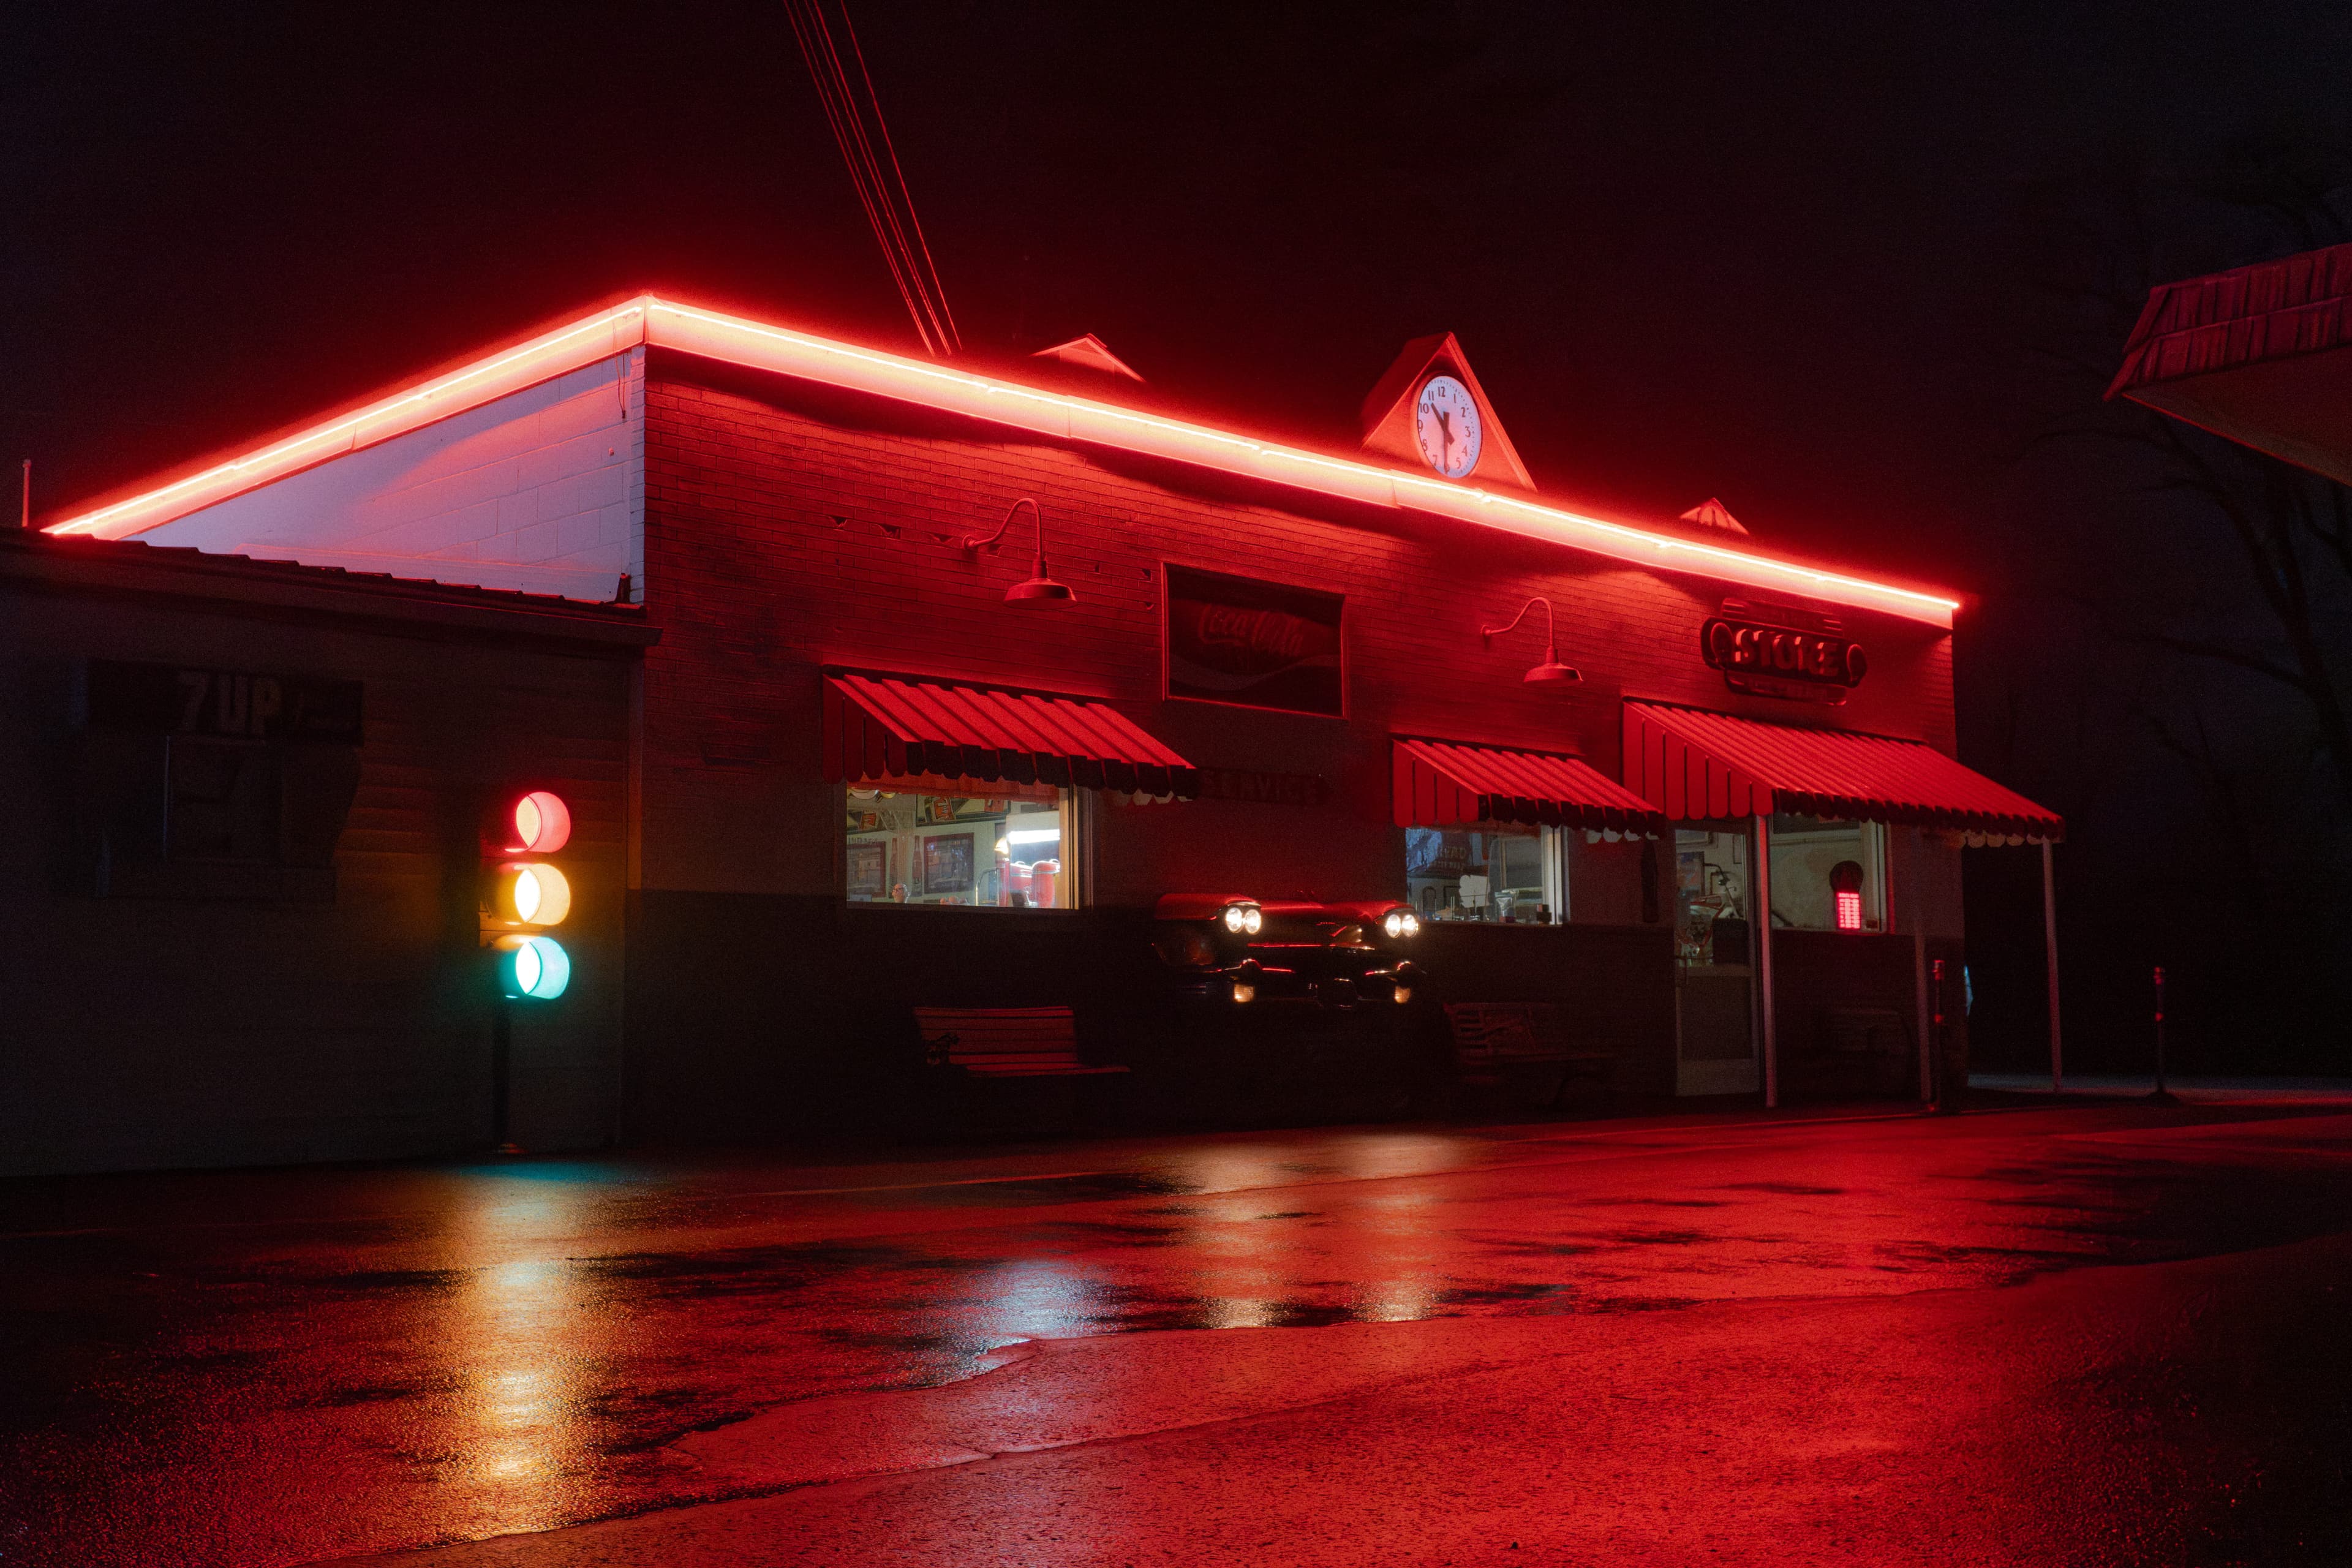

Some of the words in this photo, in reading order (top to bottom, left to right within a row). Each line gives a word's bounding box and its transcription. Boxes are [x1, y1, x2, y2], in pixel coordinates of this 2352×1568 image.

[1428, 390, 1434, 401] 11
[1438, 386, 1446, 397] 12
[1453, 394, 1457, 403] 1
[1419, 402, 1429, 413] 10
[1461, 407, 1466, 418] 2
[1418, 420, 1423, 432] 9
[1465, 426, 1471, 437] 3
[1422, 439, 1428, 451] 8
[1461, 445, 1468, 456] 4
[1432, 454, 1438, 466] 7
[1456, 457, 1461, 469] 5
[1734, 628, 1840, 677] STORE
